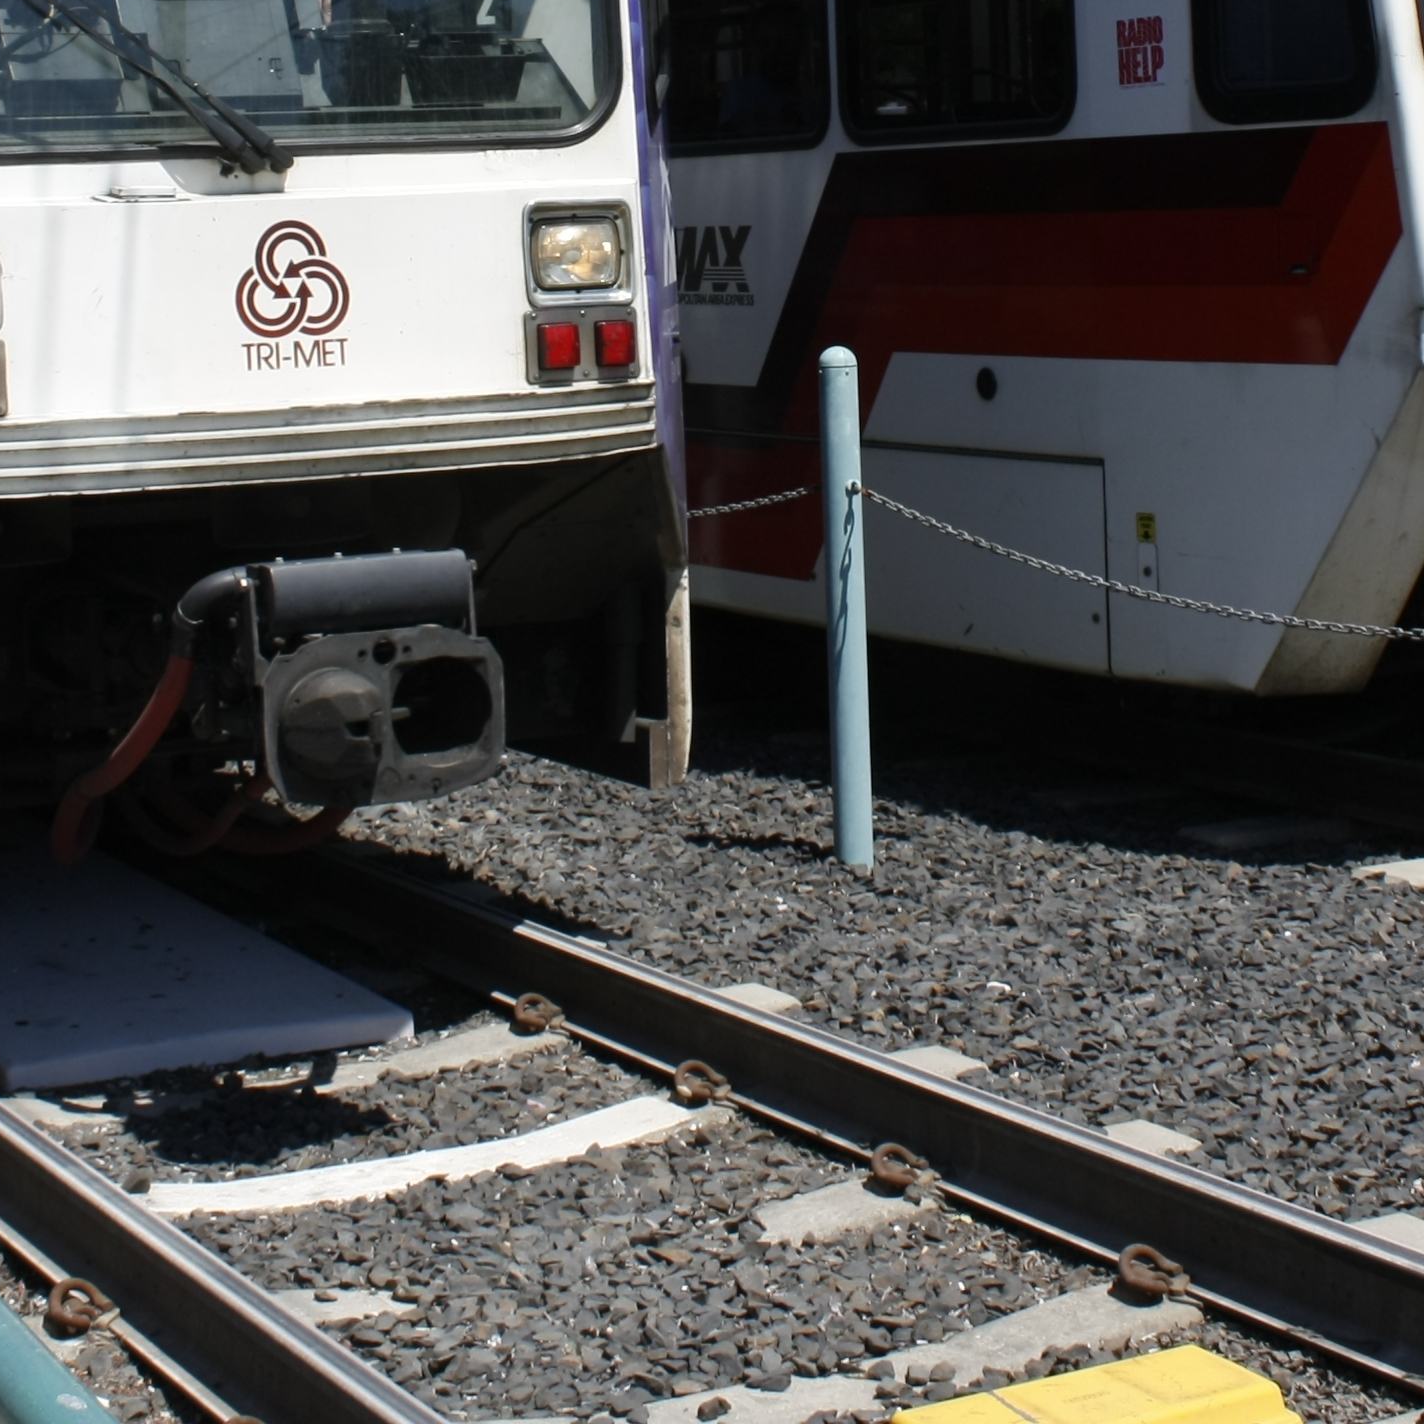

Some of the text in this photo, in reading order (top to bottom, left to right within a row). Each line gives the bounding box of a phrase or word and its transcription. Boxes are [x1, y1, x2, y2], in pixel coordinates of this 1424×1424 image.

[1116, 15, 1163, 48] RADIO
[1117, 45, 1165, 85] HELP
[725, 293, 755, 306] EXPRESS
[241, 337, 349, 372] TRI-MET
